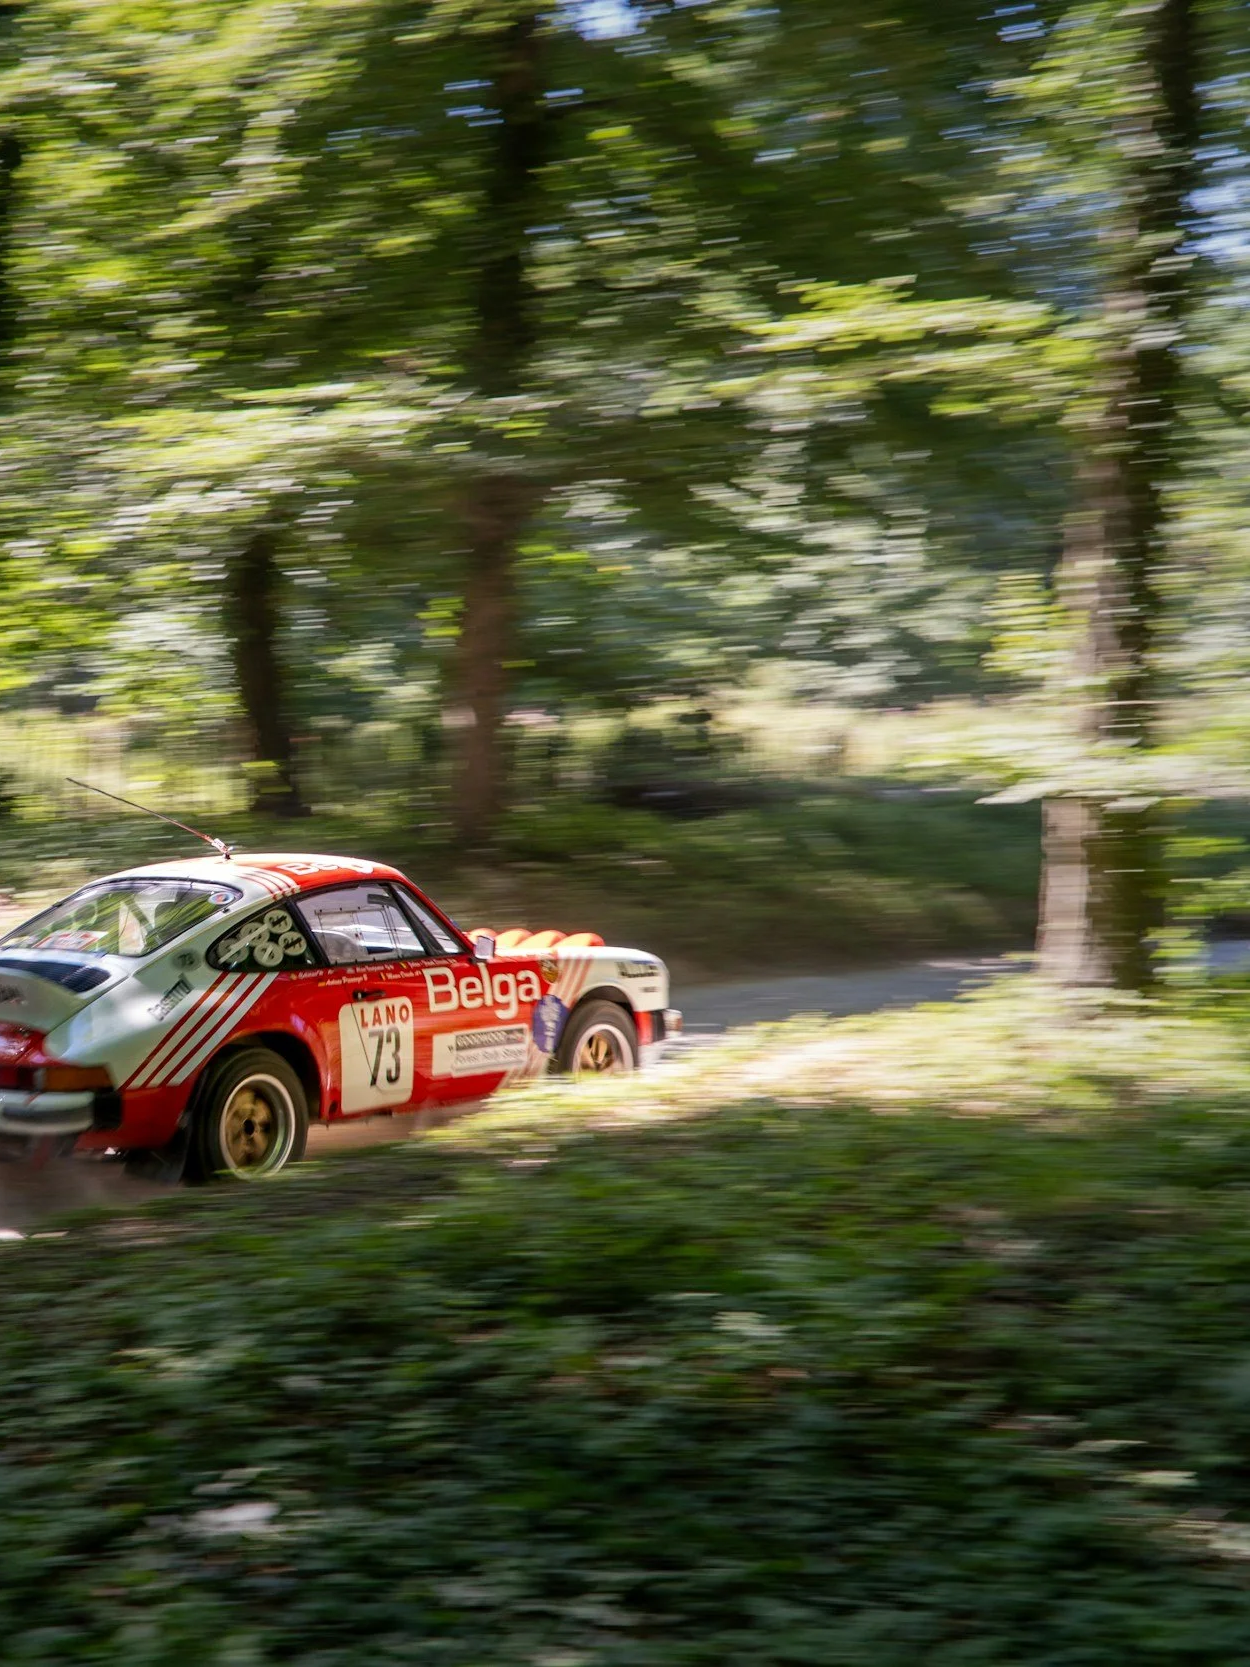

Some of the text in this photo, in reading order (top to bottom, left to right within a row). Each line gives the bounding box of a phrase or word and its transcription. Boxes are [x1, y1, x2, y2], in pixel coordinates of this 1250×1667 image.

[360, 1003, 409, 1028] LANO
[423, 962, 542, 1020] Belga
[368, 1027, 401, 1087] 73
